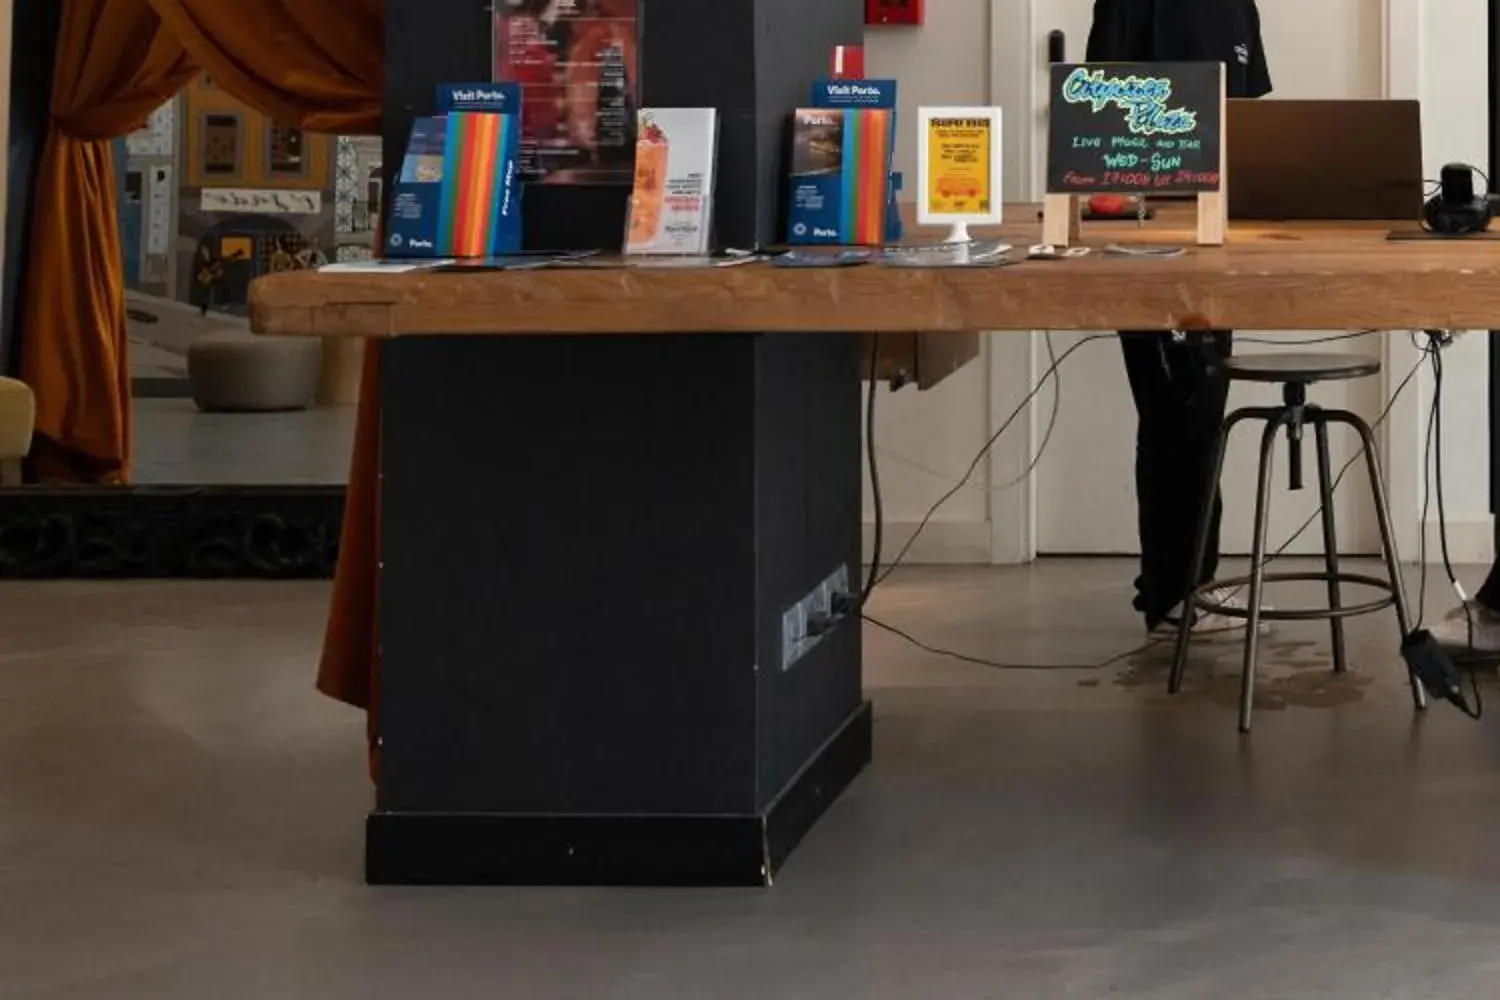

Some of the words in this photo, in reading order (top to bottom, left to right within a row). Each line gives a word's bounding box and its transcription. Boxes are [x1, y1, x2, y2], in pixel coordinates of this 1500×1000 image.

[452, 90, 476, 101] Visit
[827, 84, 851, 96] Visit
[1150, 152, 1182, 172] SUN
